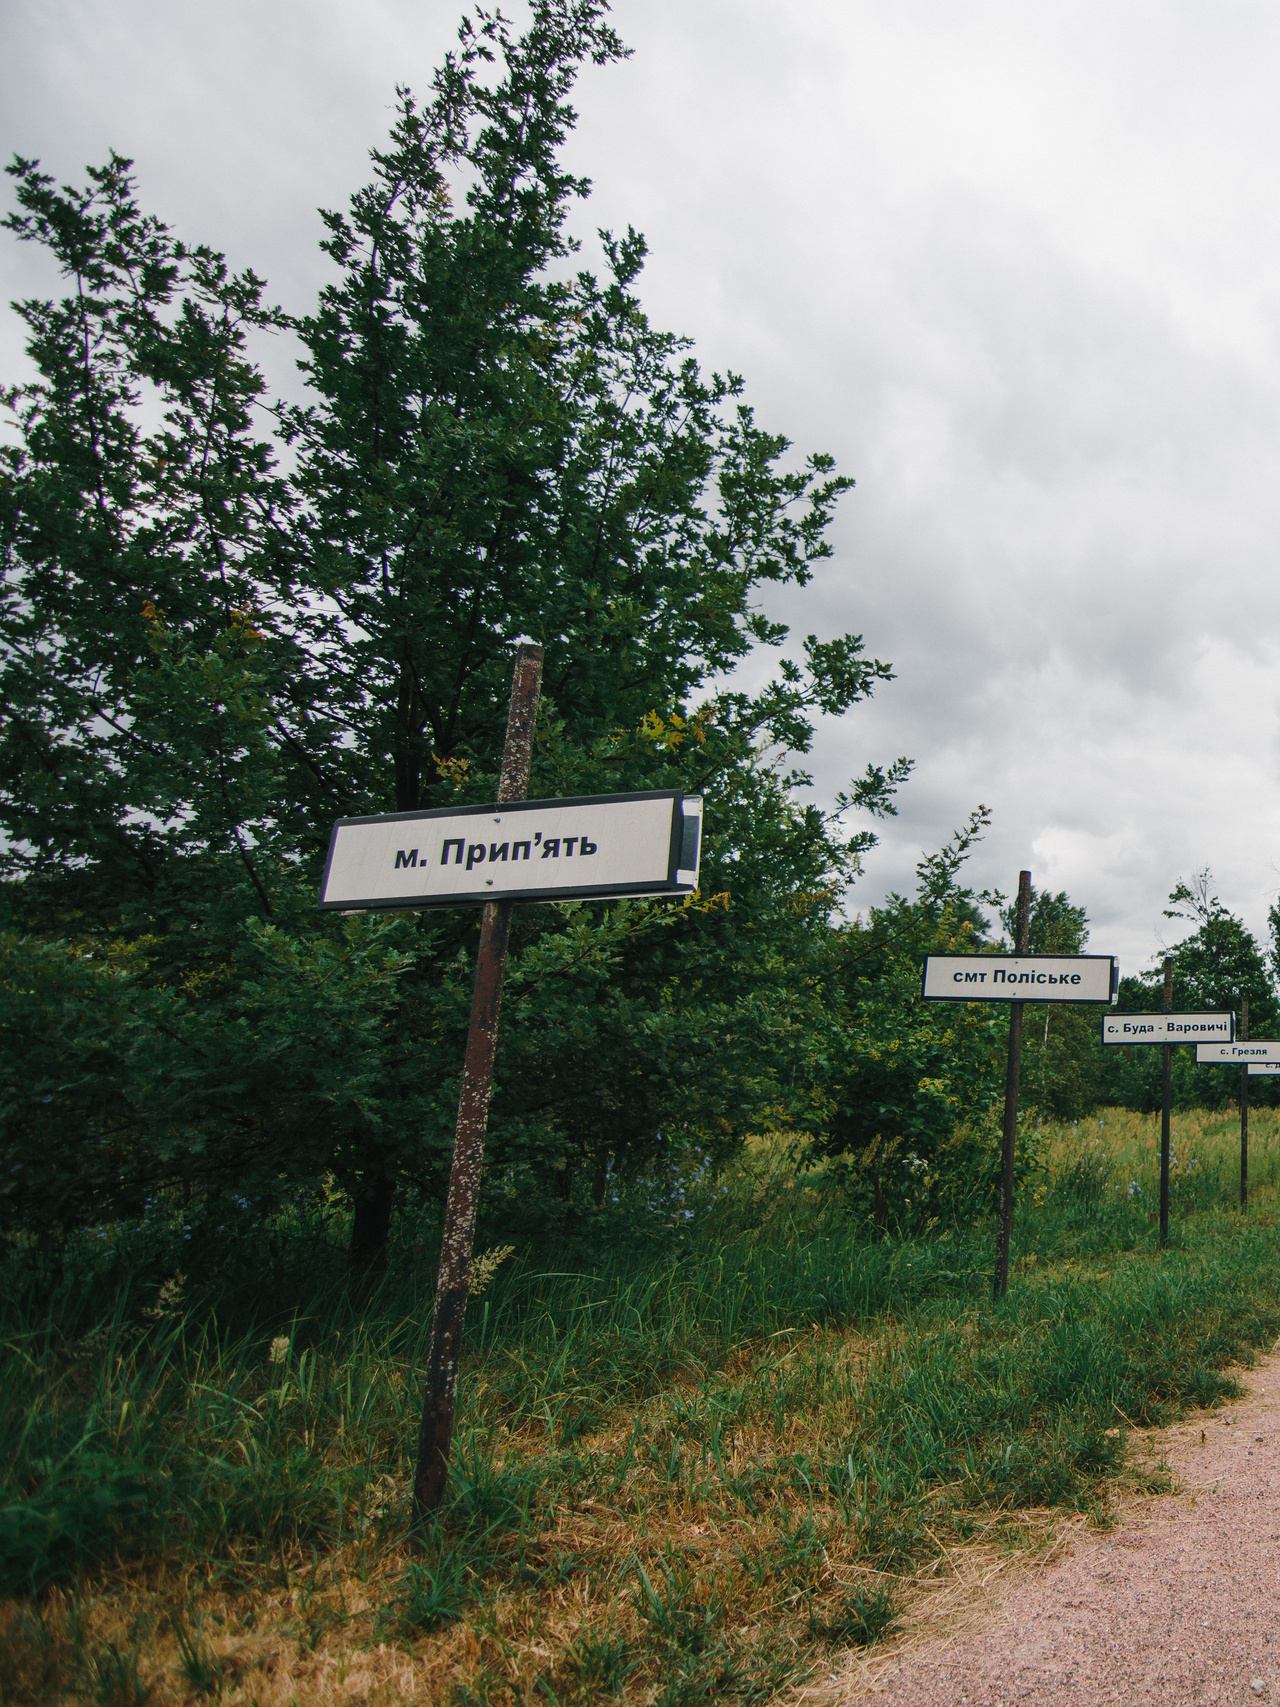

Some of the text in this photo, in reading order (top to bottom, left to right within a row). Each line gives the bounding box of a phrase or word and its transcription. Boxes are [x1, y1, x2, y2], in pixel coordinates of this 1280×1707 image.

[394, 832, 598, 871] м. Прип’ять
[953, 969, 1082, 985] смт Поліське
[1107, 1025, 1119, 1034] с.
[1123, 1023, 1155, 1035] Буда
[1166, 1021, 1227, 1034] Варовичі
[1232, 1047, 1268, 1057] Грезля
